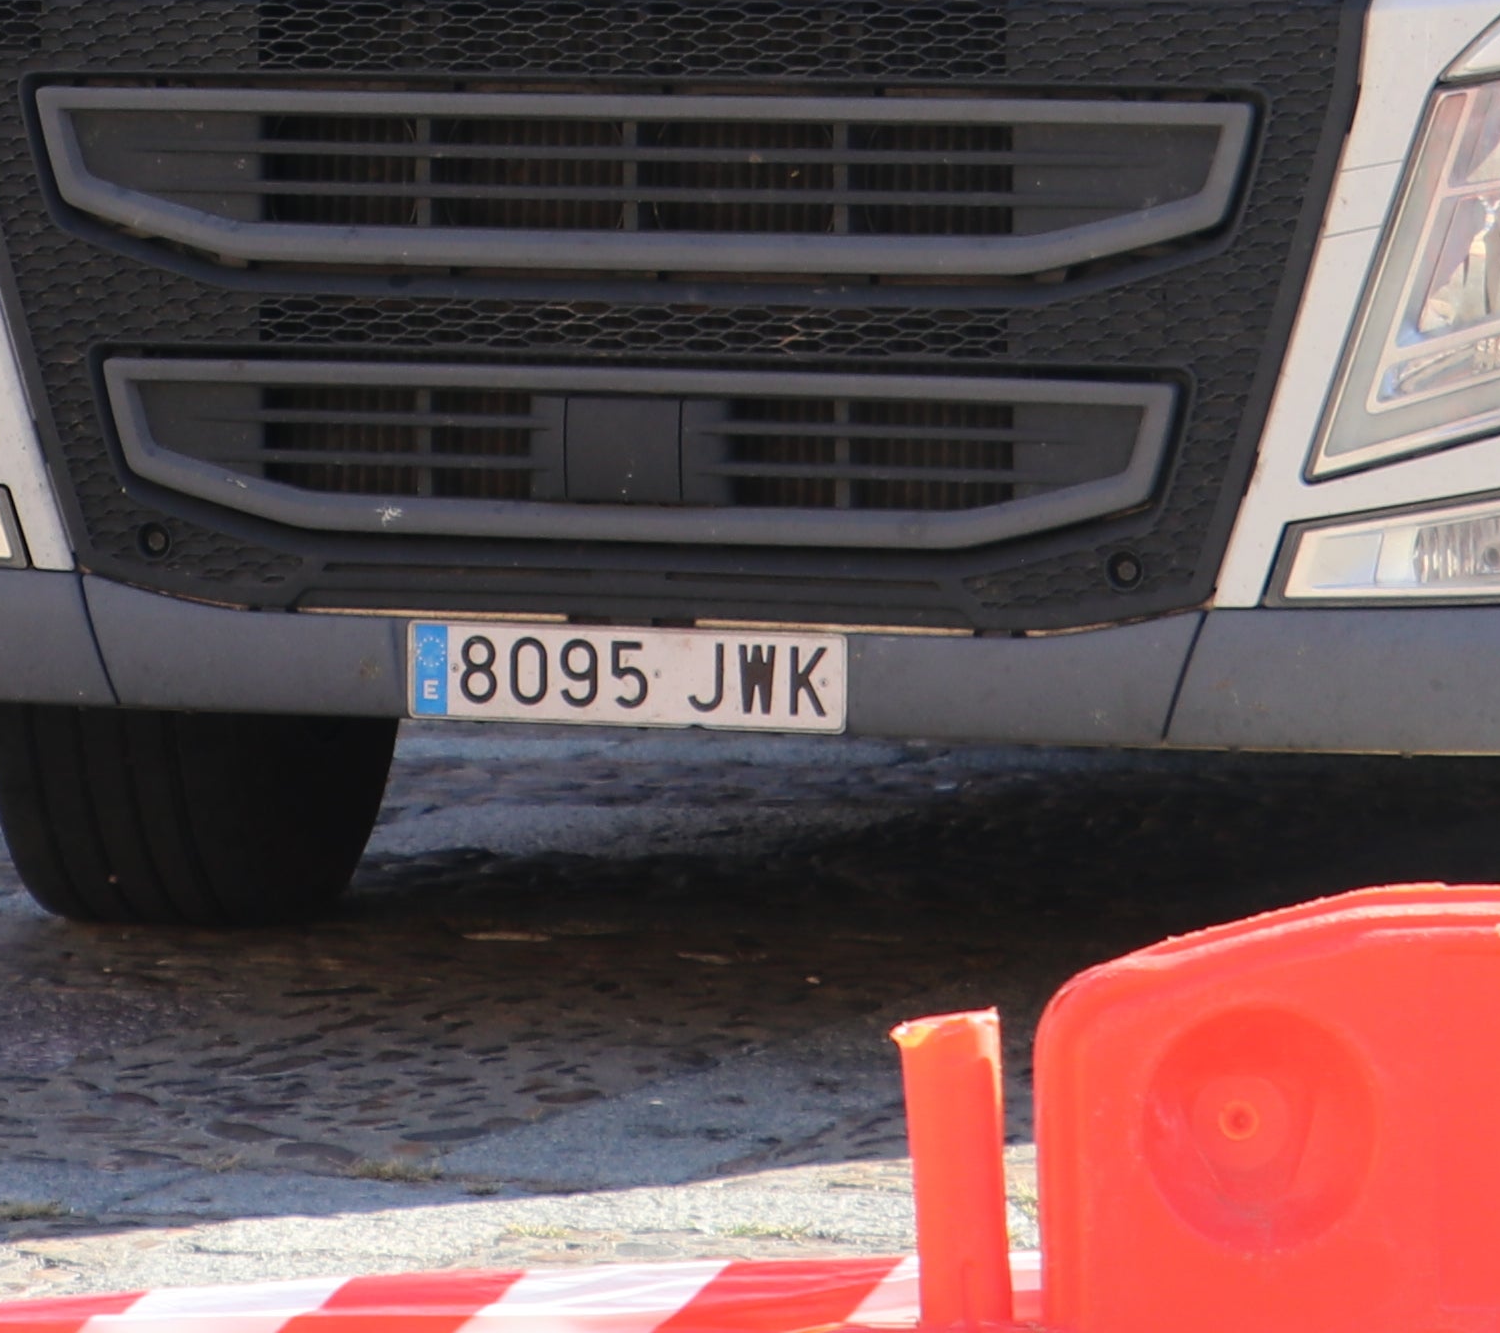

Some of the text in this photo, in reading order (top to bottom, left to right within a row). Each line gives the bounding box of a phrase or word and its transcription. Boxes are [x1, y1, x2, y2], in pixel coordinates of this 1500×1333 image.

[423, 635, 827, 717] E 8095 JWK
